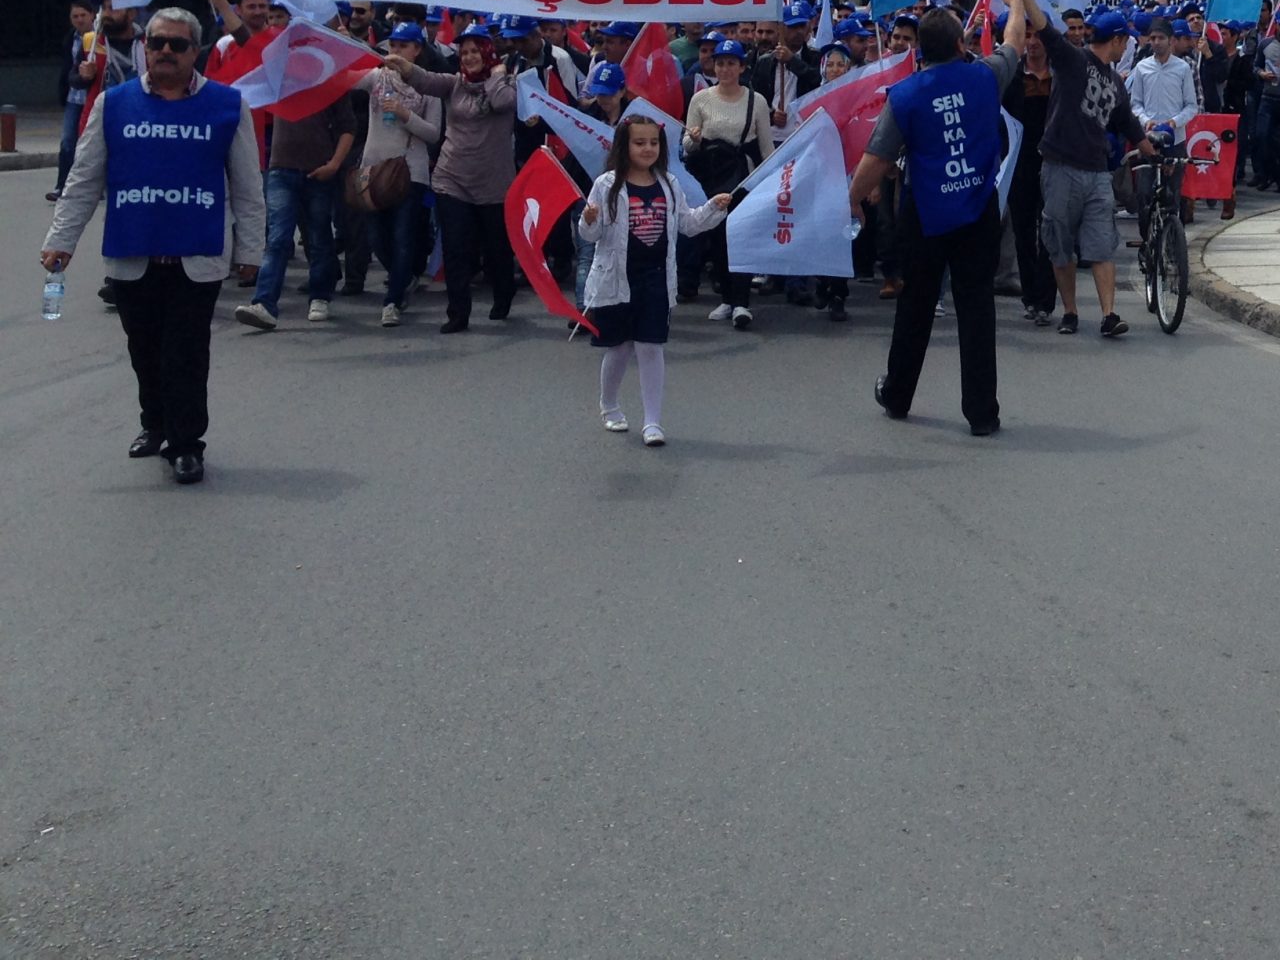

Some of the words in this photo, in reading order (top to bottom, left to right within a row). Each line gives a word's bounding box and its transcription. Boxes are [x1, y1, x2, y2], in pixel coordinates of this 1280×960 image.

[932, 92, 965, 113] SEN
[943, 127, 967, 144] KA
[945, 158, 976, 178] OL
[116, 185, 215, 209] petrol-iş
